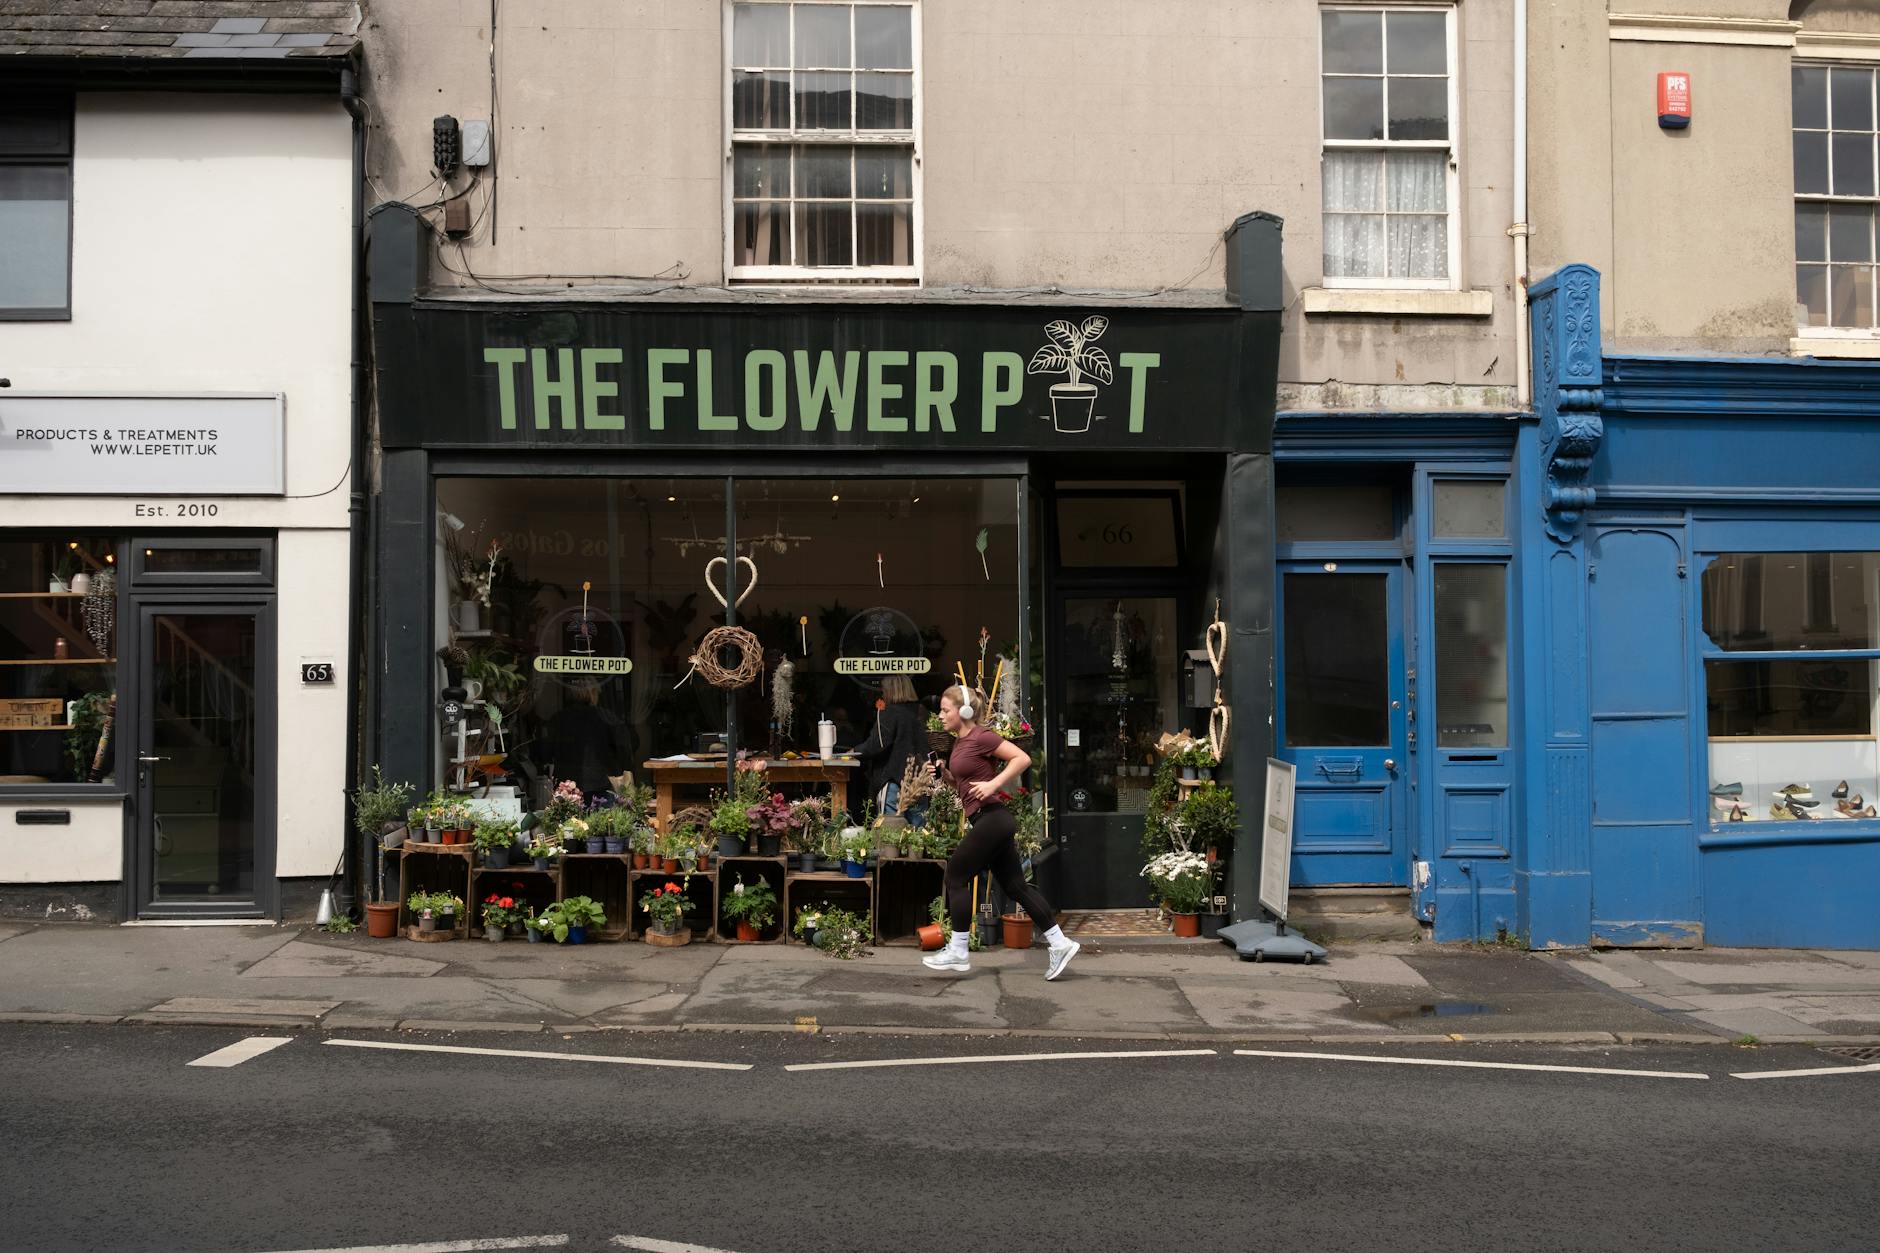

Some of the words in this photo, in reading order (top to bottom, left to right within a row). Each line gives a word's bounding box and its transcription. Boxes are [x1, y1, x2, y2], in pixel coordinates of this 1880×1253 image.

[1667, 76, 1687, 90] PFS
[483, 347, 626, 430] THE
[647, 348, 959, 433] FLOWER
[16, 429, 98, 441] PRODUCTS
[103, 429, 112, 441] &
[118, 429, 218, 441] TREATMENTS
[90, 443, 217, 456] WWW.LEPETIT.UK
[135, 503, 169, 517] Est.
[177, 503, 218, 517] 2010
[1102, 522, 1133, 545] 66
[540, 658, 558, 670] THE
[562, 659, 605, 671] FLOWER
[608, 660, 627, 671] POT
[840, 660, 858, 671] THE
[862, 660, 904, 671] FLOWER
[907, 660, 926, 671] POT
[306, 664, 327, 681] 65
